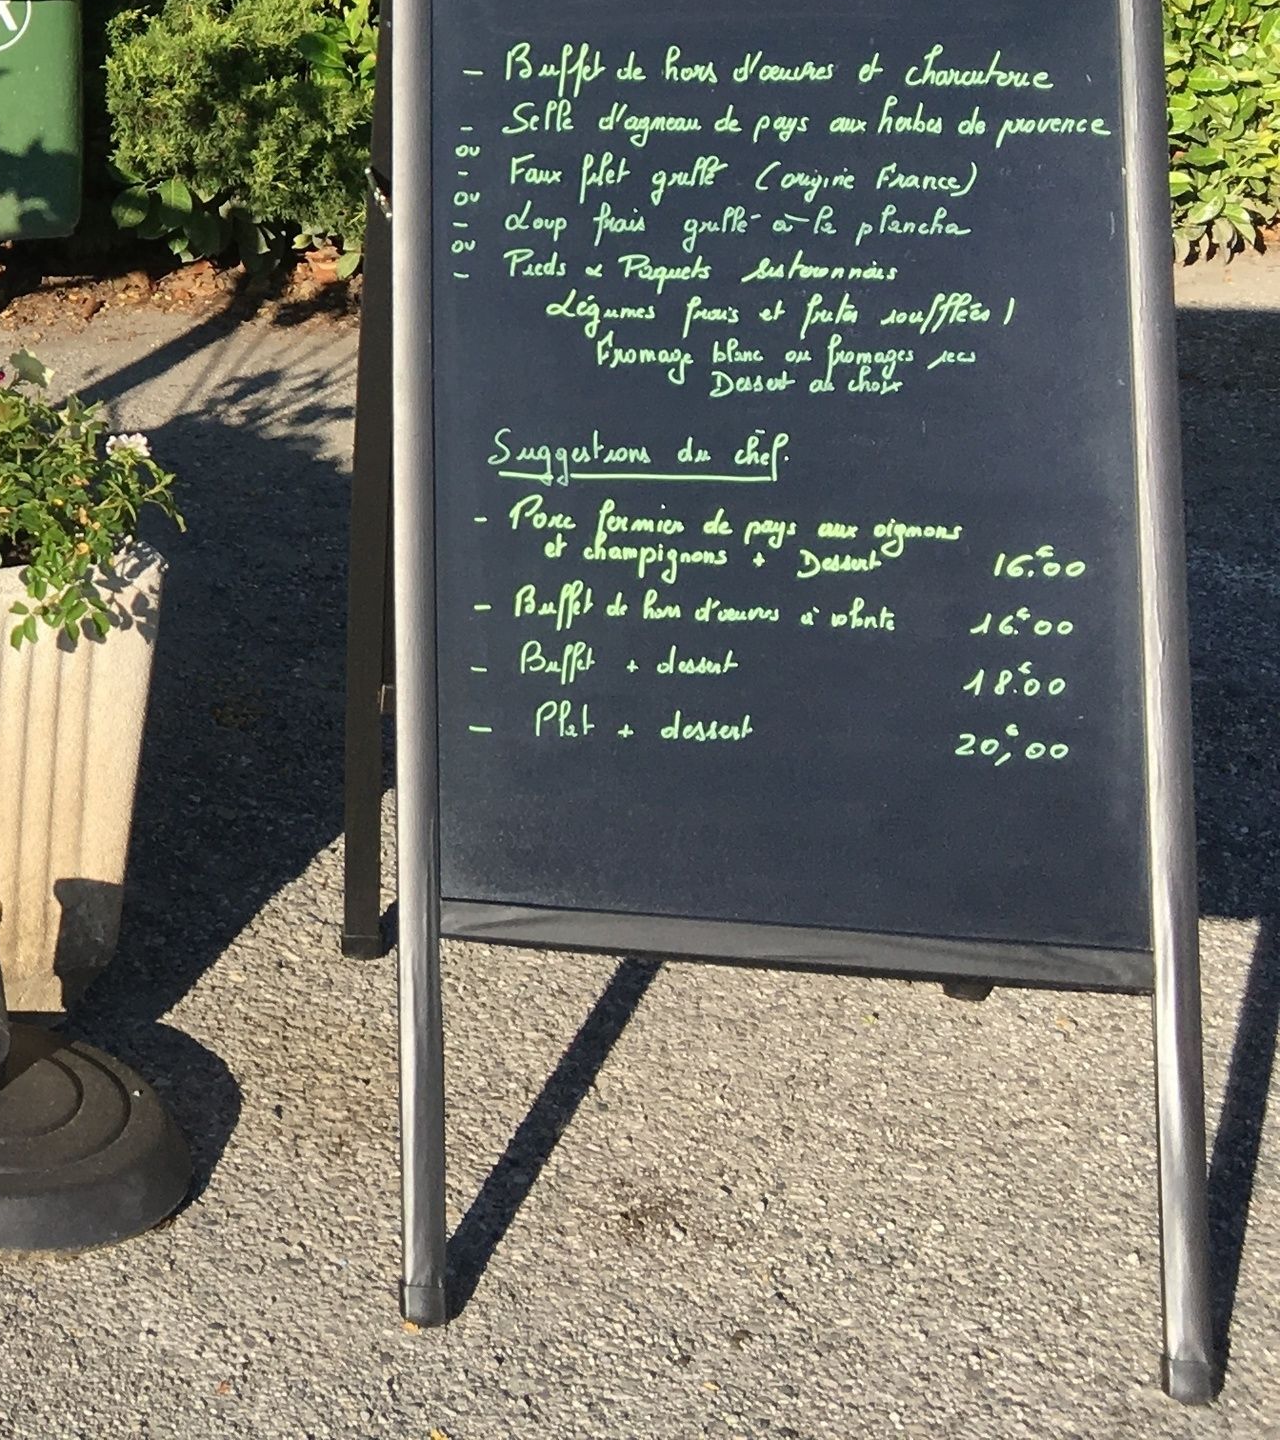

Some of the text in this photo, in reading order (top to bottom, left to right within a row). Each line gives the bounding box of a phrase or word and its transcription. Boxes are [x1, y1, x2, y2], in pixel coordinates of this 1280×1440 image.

[505, 42, 606, 98] Buffet
[617, 51, 646, 81] de
[662, 46, 718, 83] hors
[859, 52, 883, 84] et
[501, 99, 575, 134] Selle
[598, 102, 702, 147] d'agneau
[714, 104, 742, 133] de
[753, 115, 809, 144] pays
[829, 117, 867, 134] aux
[878, 95, 942, 134] herbes
[958, 106, 986, 135] de
[996, 118, 1111, 149] provence
[510, 154, 562, 185] Faux
[579, 151, 632, 205] filet
[876, 162, 977, 197] France)
[505, 200, 567, 242] Loup
[593, 202, 645, 246] frais
[855, 204, 971, 246] plancha
[503, 248, 566, 277] Pieds
[617, 254, 712, 295] Paquets
[545, 288, 656, 339] Légumes
[759, 300, 785, 321] et
[596, 330, 694, 385] Fromage
[822, 334, 914, 386] fromages
[709, 371, 795, 397] Dessert
[488, 428, 653, 486] Suggestions
[677, 436, 711, 463] du
[509, 494, 576, 534] Porc
[703, 508, 733, 535] de
[744, 520, 797, 549] pays
[817, 522, 858, 539] aux
[544, 533, 567, 558] et
[582, 530, 728, 585] champignons
[796, 548, 883, 579] Dessert
[514, 580, 593, 631] Buffet
[606, 592, 628, 616] de
[520, 640, 595, 685] Buffet
[657, 645, 738, 674] dessert
[536, 700, 595, 737] Plat
[661, 710, 753, 742] dessert
